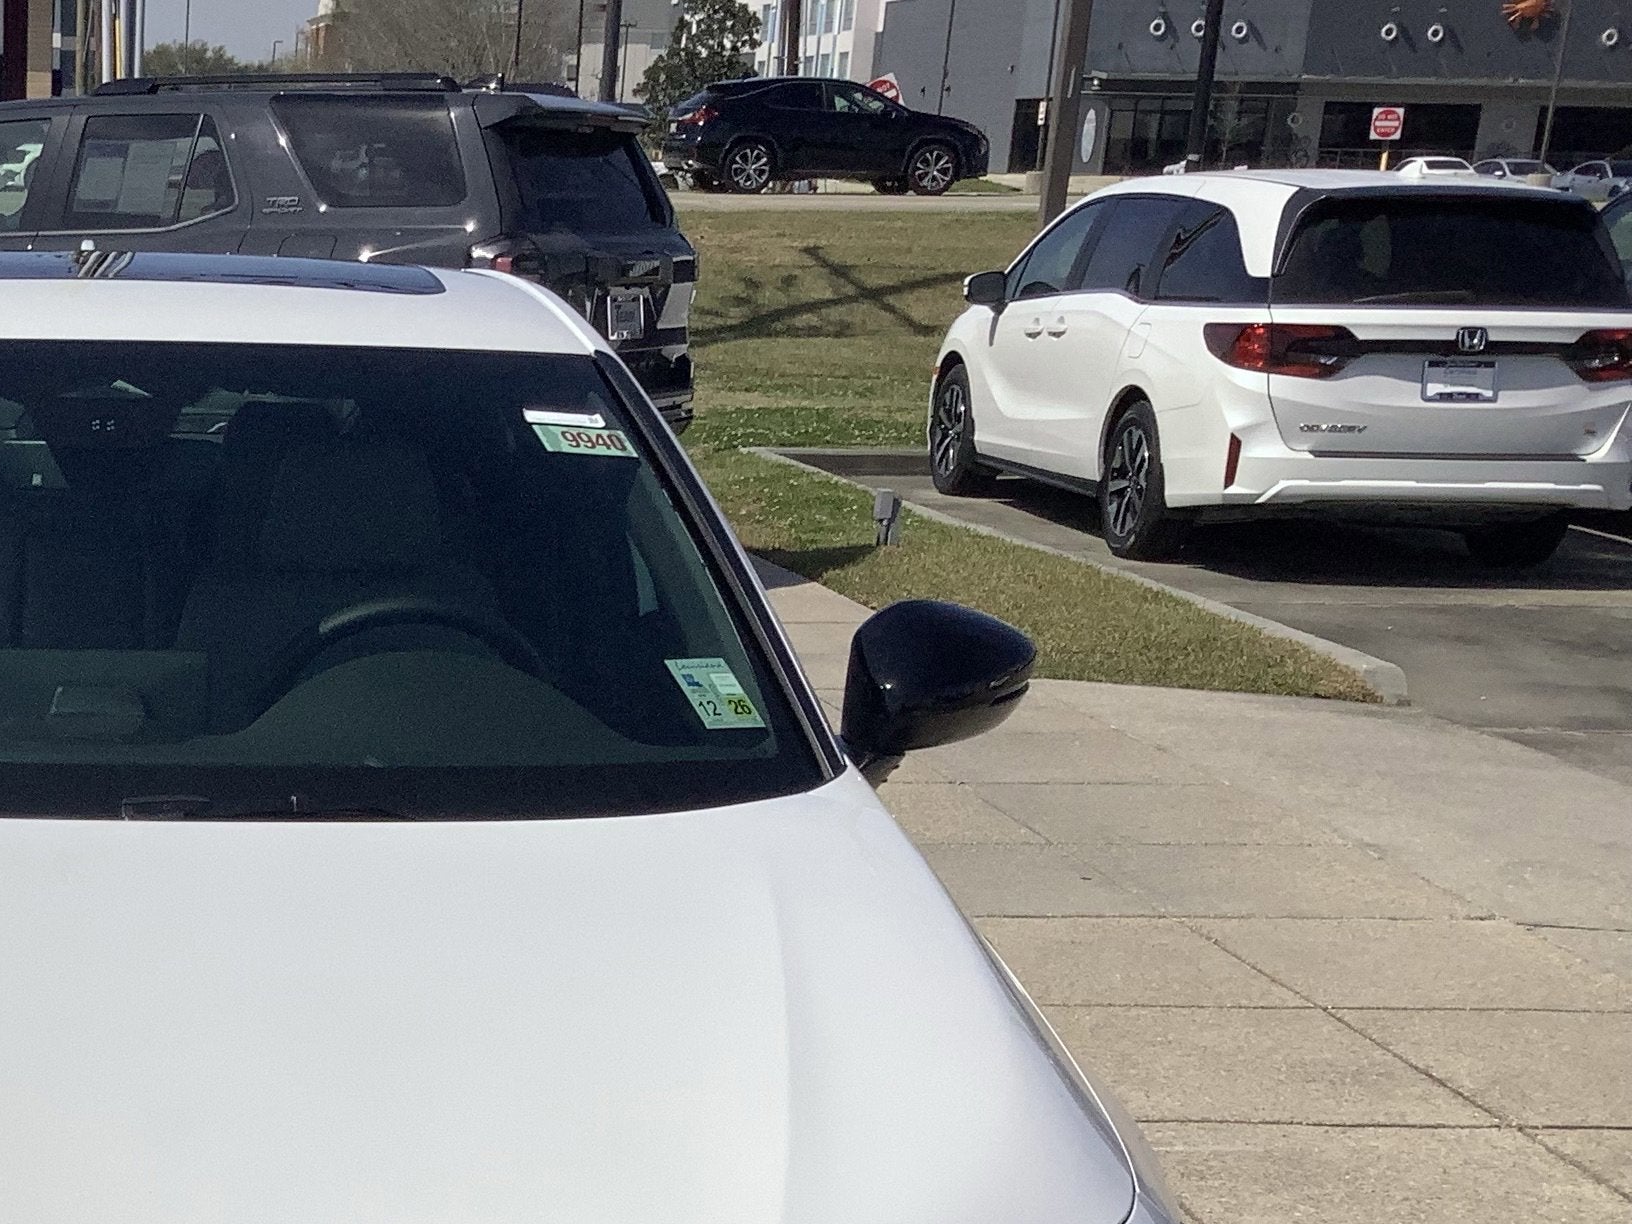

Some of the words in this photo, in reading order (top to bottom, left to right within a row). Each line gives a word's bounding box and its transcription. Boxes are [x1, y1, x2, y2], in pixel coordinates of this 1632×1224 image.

[560, 430, 628, 452] 9940
[698, 700, 722, 717] 12
[728, 699, 752, 715] 26
